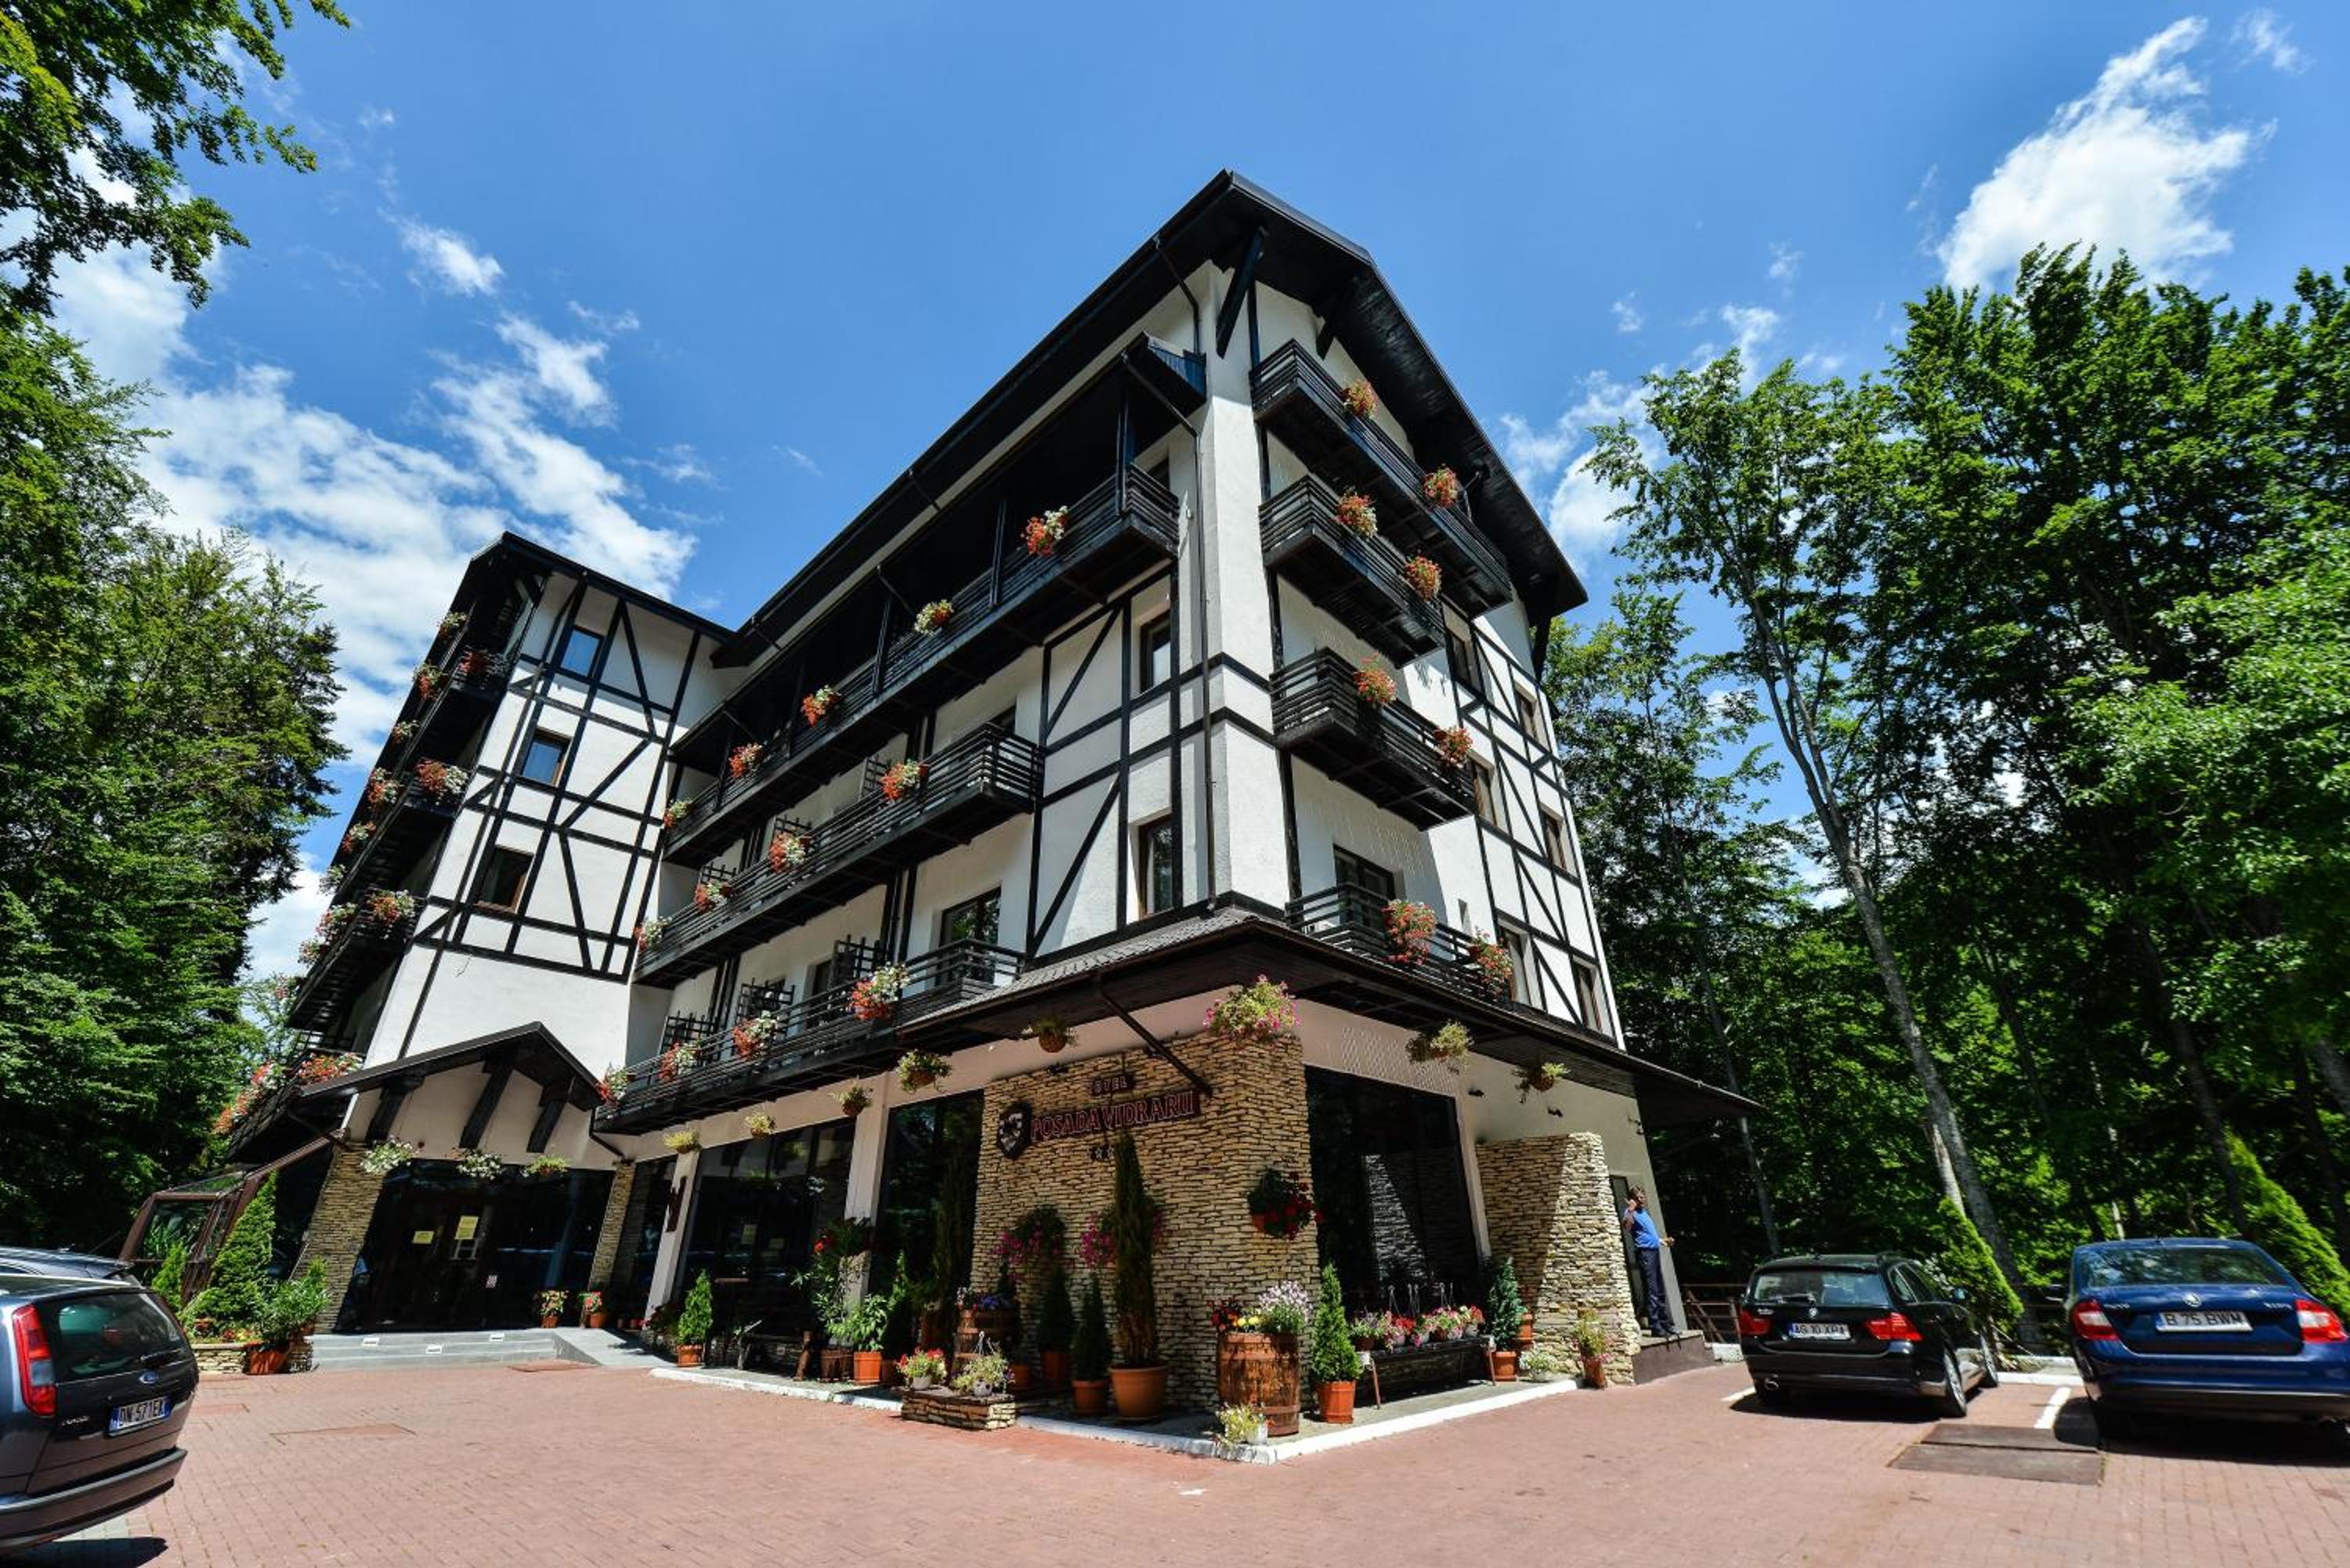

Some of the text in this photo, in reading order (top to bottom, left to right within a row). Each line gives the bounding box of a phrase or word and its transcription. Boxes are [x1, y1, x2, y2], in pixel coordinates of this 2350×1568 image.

[1030, 1109, 1101, 1141] POSADA
[2164, 1312, 2178, 1325] B
[2180, 1312, 2201, 1325] 75
